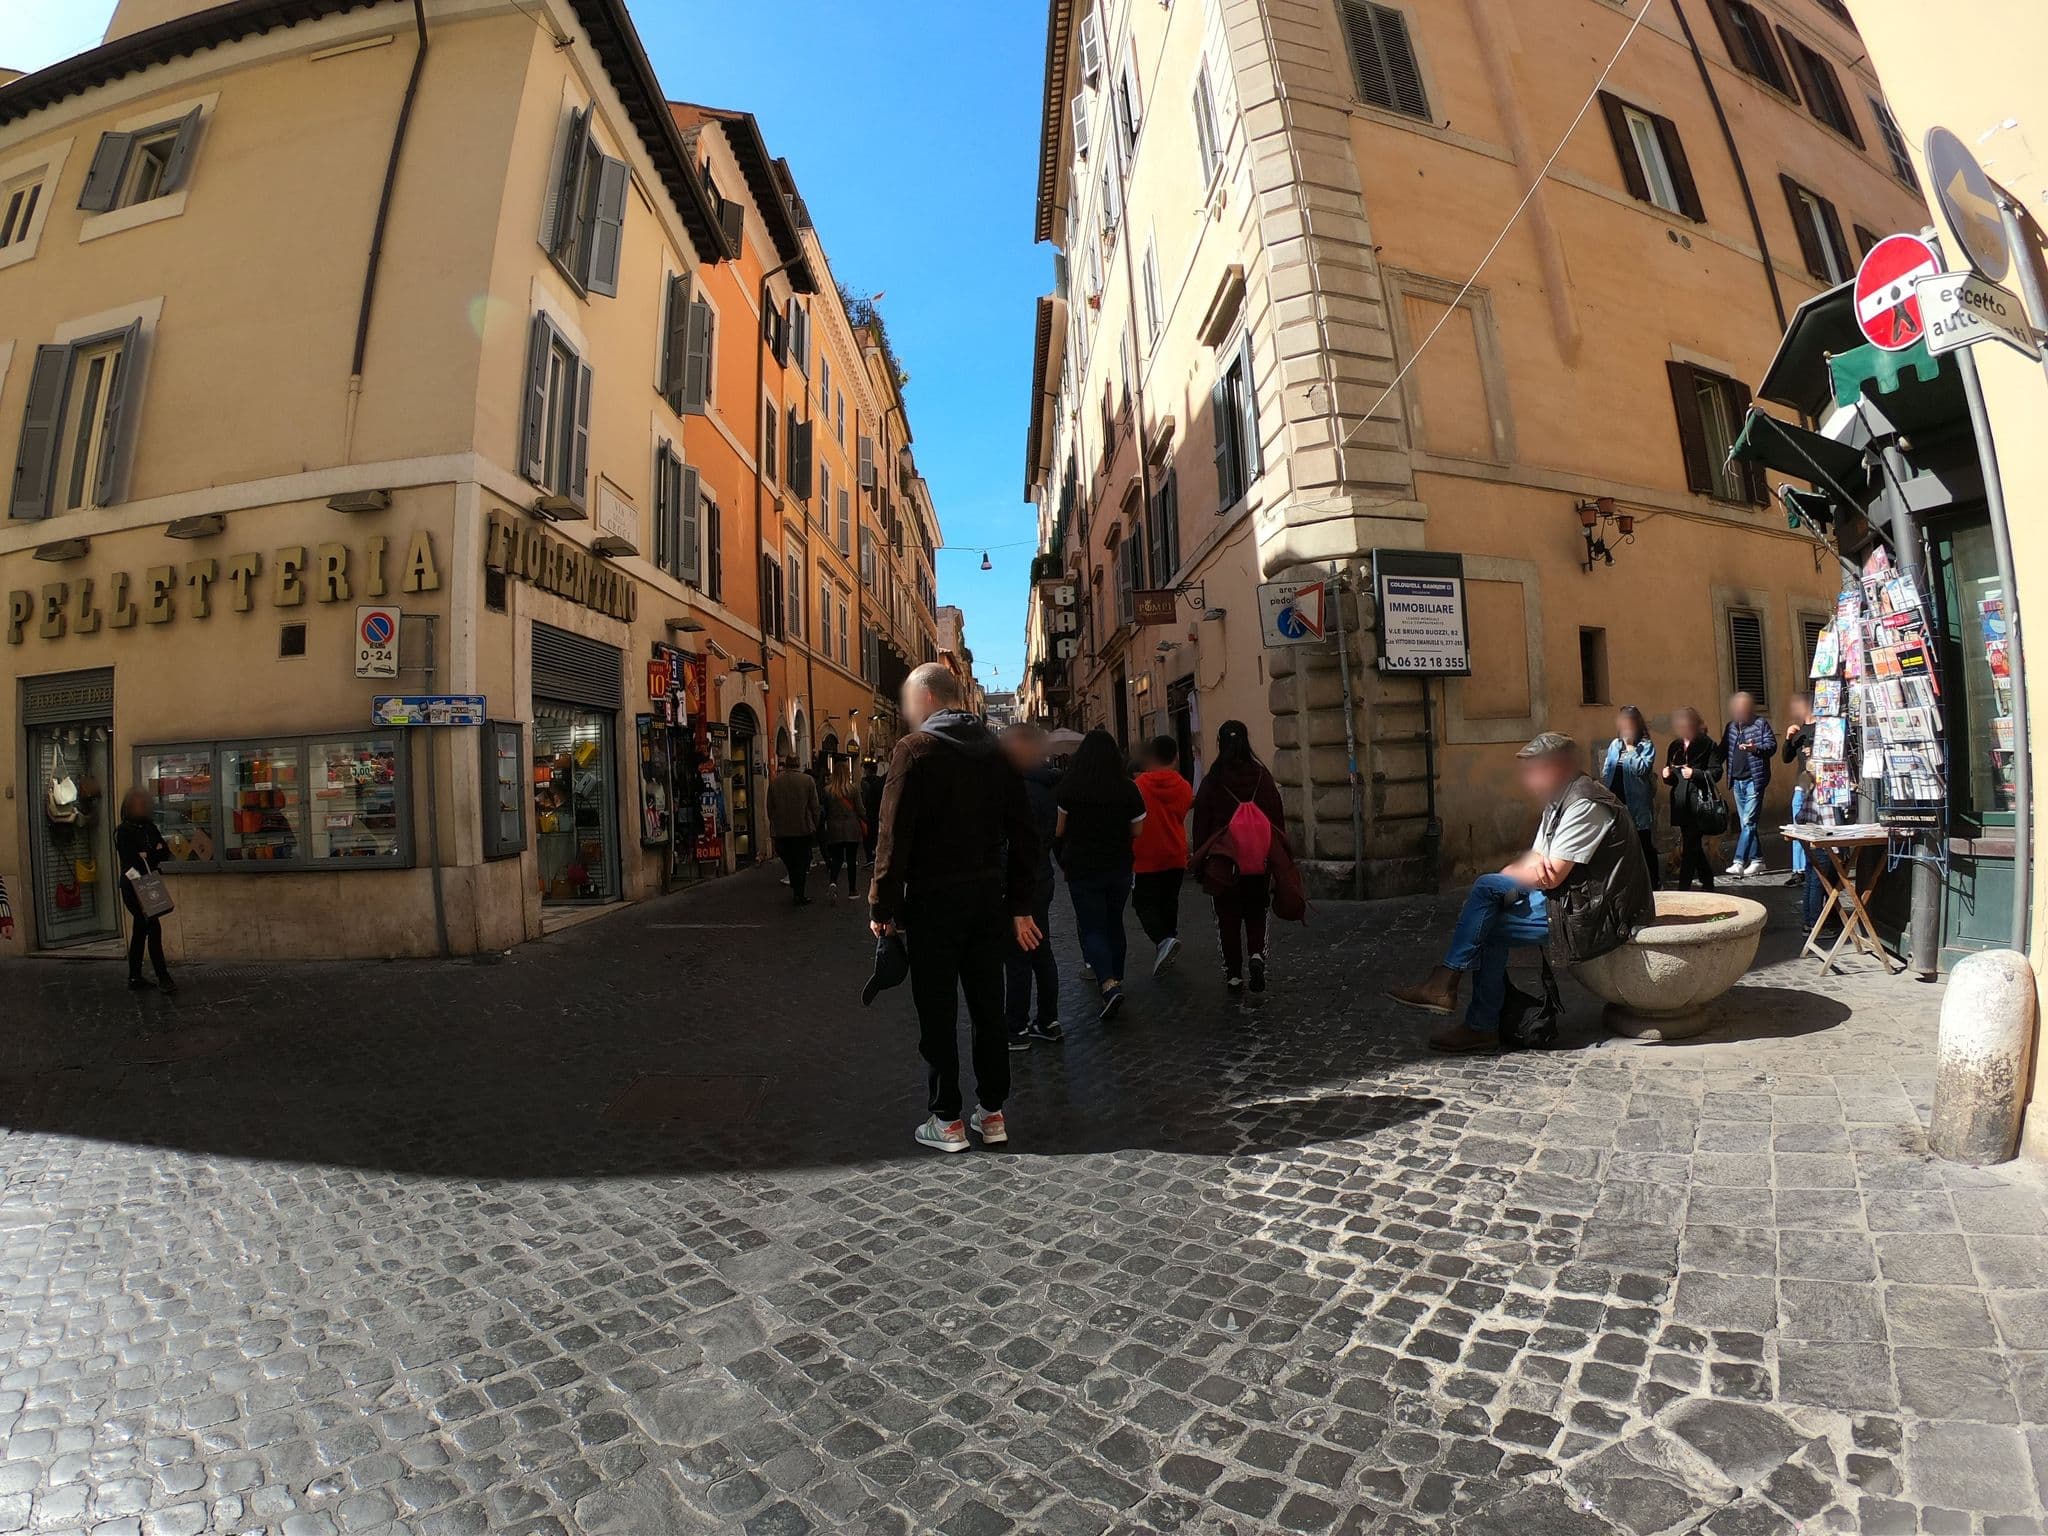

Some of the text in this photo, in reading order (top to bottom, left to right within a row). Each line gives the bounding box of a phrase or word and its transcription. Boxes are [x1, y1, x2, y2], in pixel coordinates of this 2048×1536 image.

[1940, 287, 2006, 316] eccetto
[486, 508, 638, 623] FIORENTINO
[7, 529, 441, 645] PELLETTERIA
[1270, 596, 1294, 606] pedo
[1389, 602, 1454, 614] IMMOBILIARE
[361, 650, 393, 661] 0-24
[1397, 657, 1464, 668] 06 32 18 355
[650, 674, 665, 695] 10
[696, 848, 721, 859] ROMA
